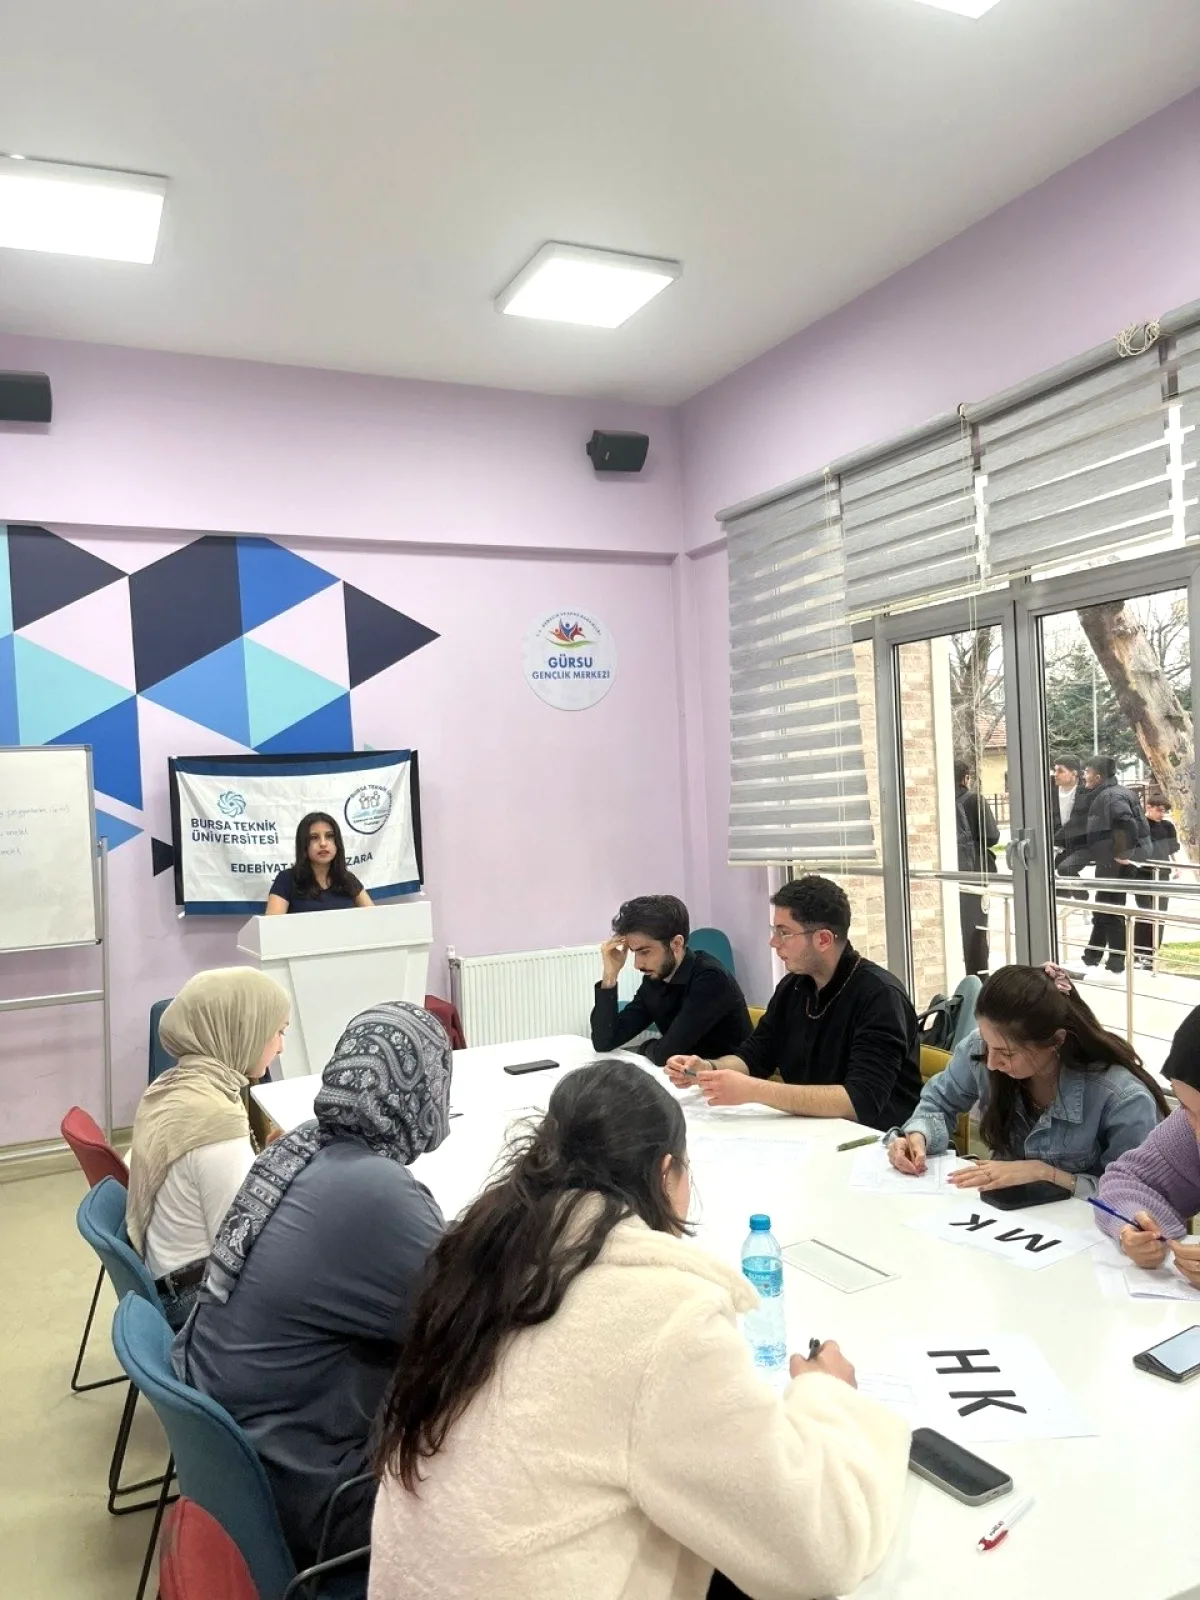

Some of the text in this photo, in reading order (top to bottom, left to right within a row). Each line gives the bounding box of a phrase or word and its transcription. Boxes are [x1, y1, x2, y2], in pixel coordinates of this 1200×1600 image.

[548, 653, 593, 668] GÜRSU
[190, 818, 277, 832] BURSA TEKNİK
[191, 829, 279, 845] ÜNİVERSİTESİ
[230, 861, 288, 874] EDEBİYAT
